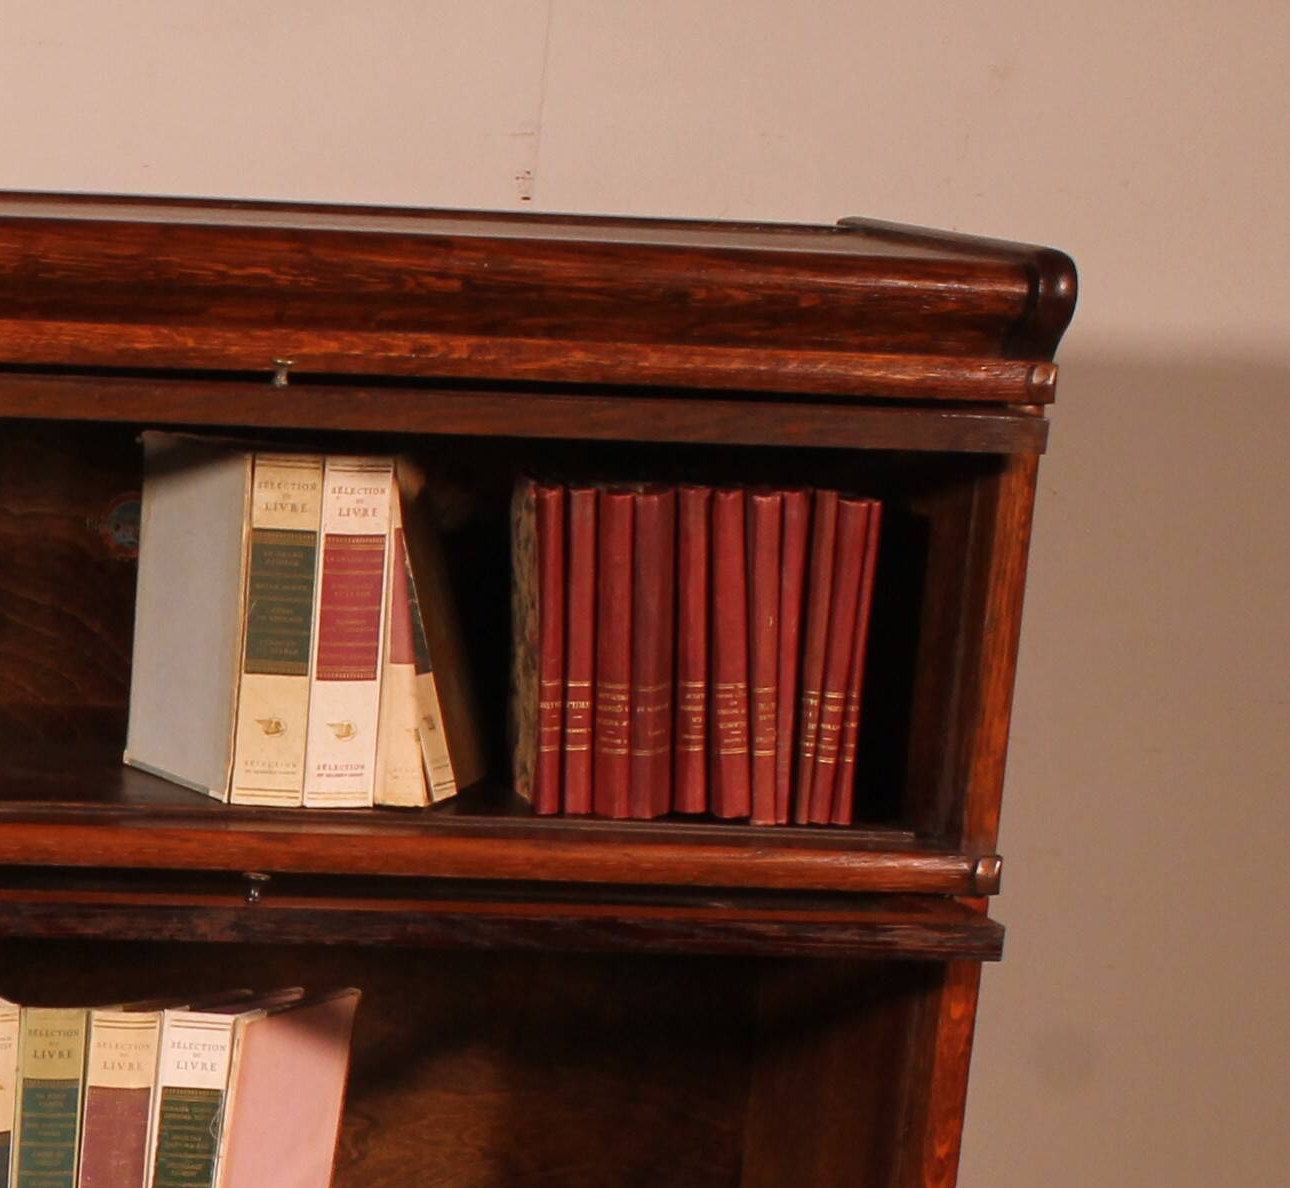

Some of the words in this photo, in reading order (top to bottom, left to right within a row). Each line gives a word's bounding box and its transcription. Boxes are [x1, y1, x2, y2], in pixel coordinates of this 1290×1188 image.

[264, 502, 309, 514] LIVRE
[338, 507, 380, 518] LIVRE
[32, 1049, 73, 1060] LIVRE
[103, 1061, 144, 1072] LIVRE
[176, 1062, 218, 1073] LIVRE
